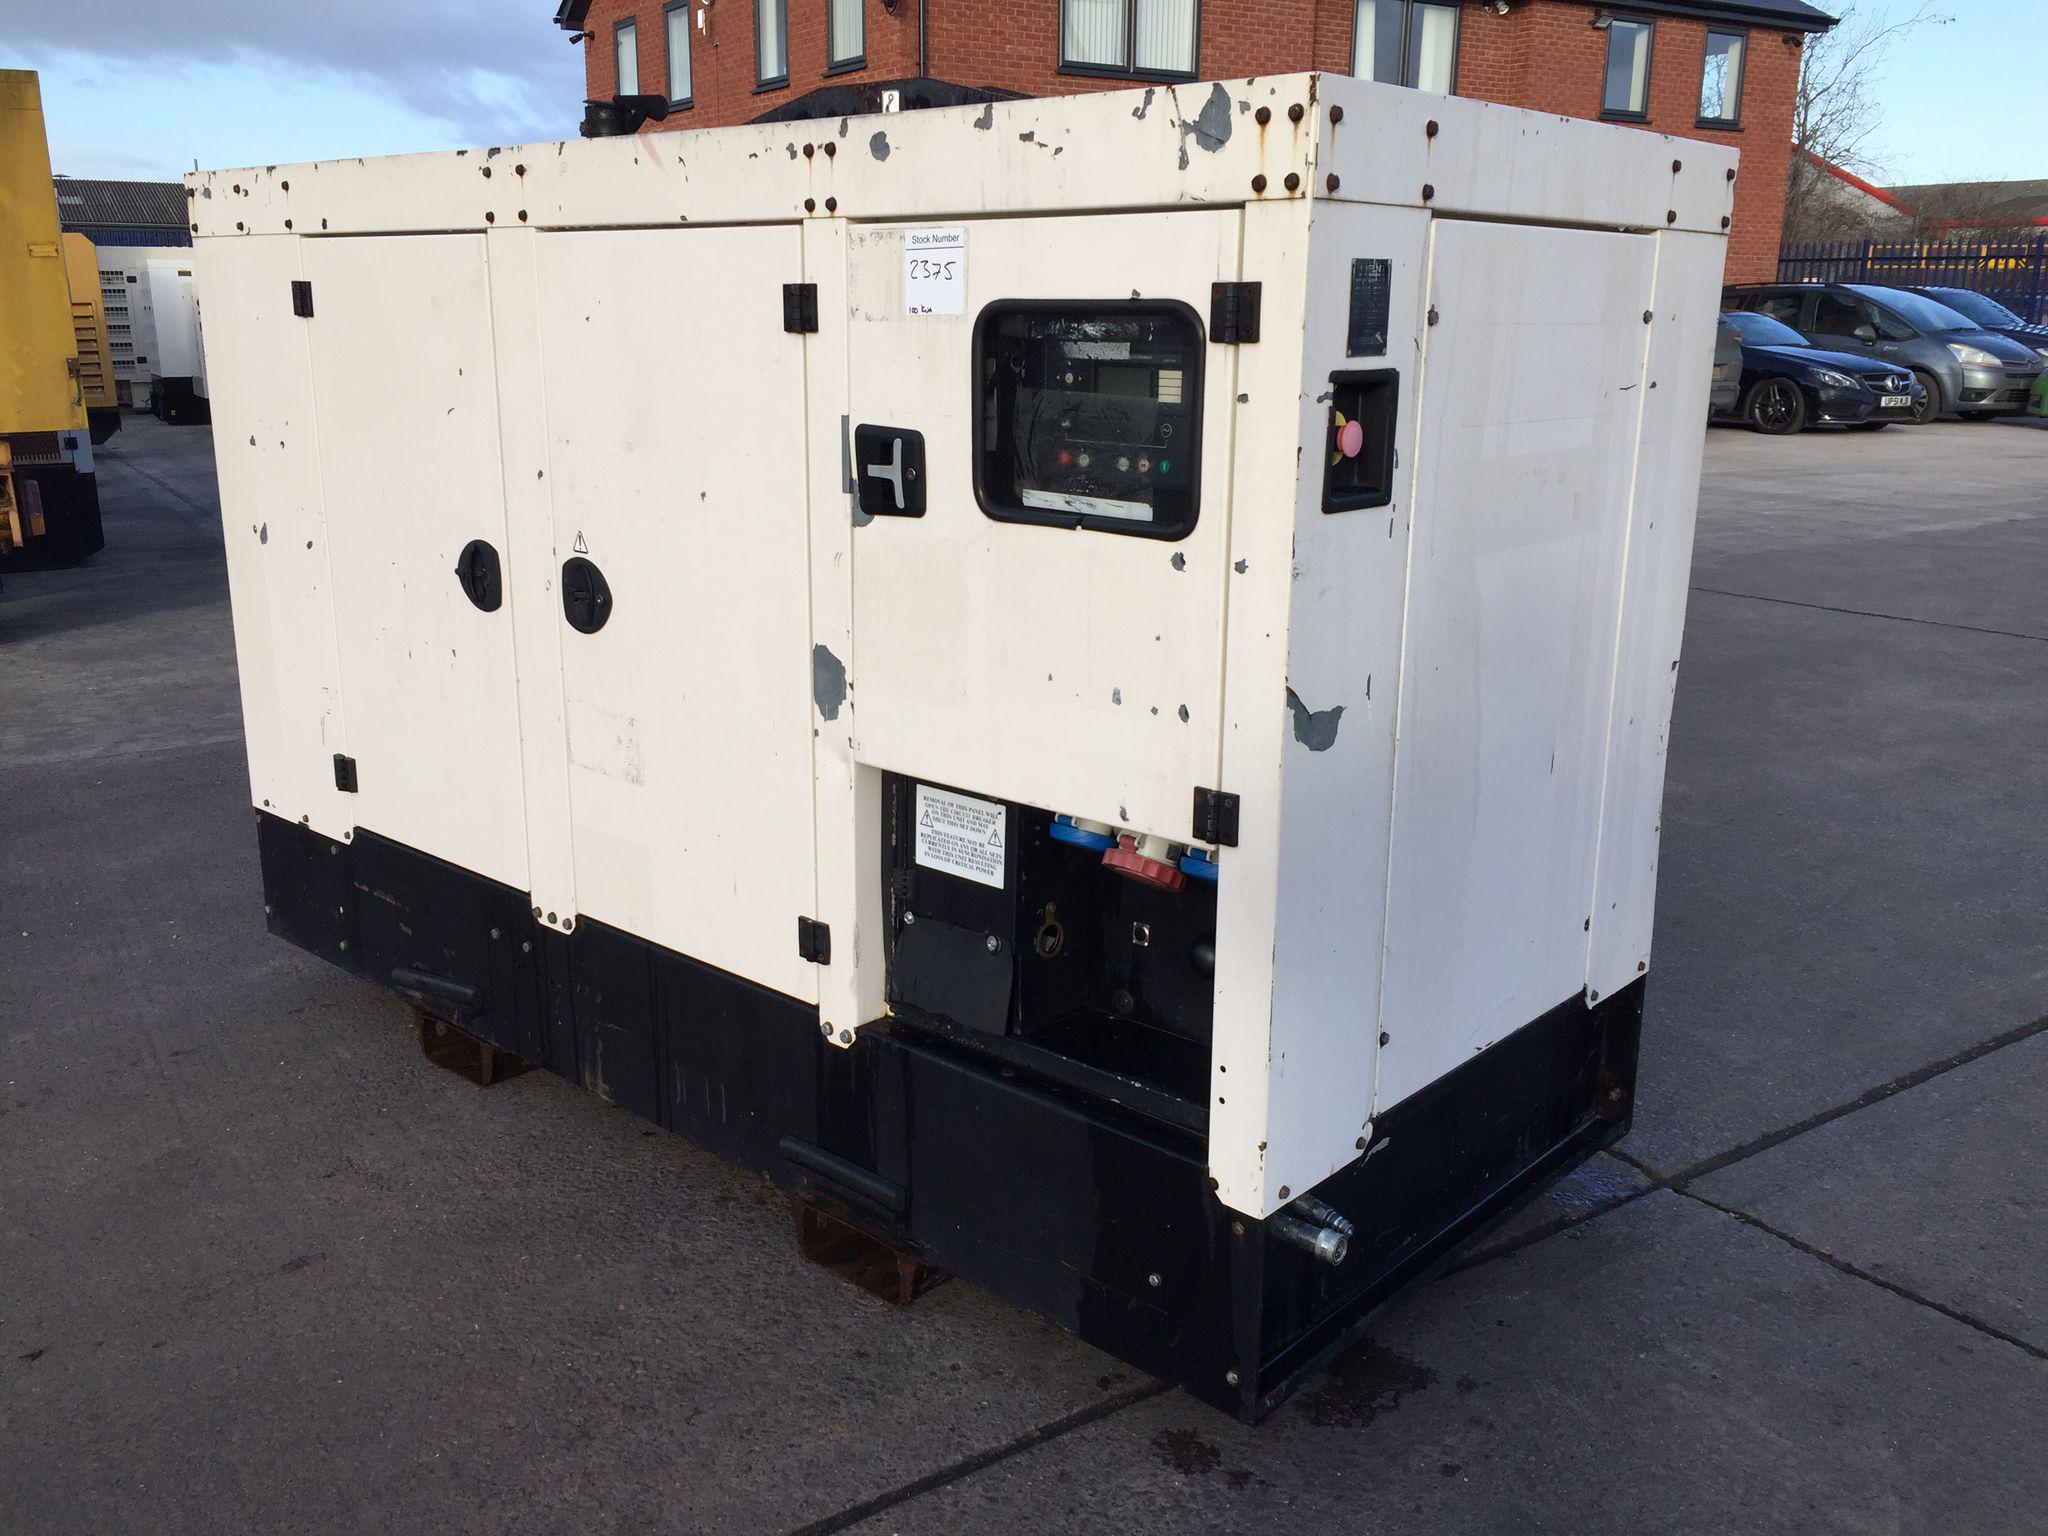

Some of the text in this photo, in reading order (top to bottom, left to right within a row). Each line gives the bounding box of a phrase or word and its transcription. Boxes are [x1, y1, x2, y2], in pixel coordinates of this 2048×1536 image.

[912, 234, 960, 244] Stock Number
[910, 260, 957, 280] 2375
[923, 796, 945, 806] REMOVAL
[968, 807, 983, 815] PANEL
[920, 832, 949, 845] REPLICATED
[921, 839, 949, 850] CURRENTLY
[952, 860, 974, 870] CRITICAL
[975, 866, 994, 876] POWER
[968, 858, 996, 870] RESULTING
